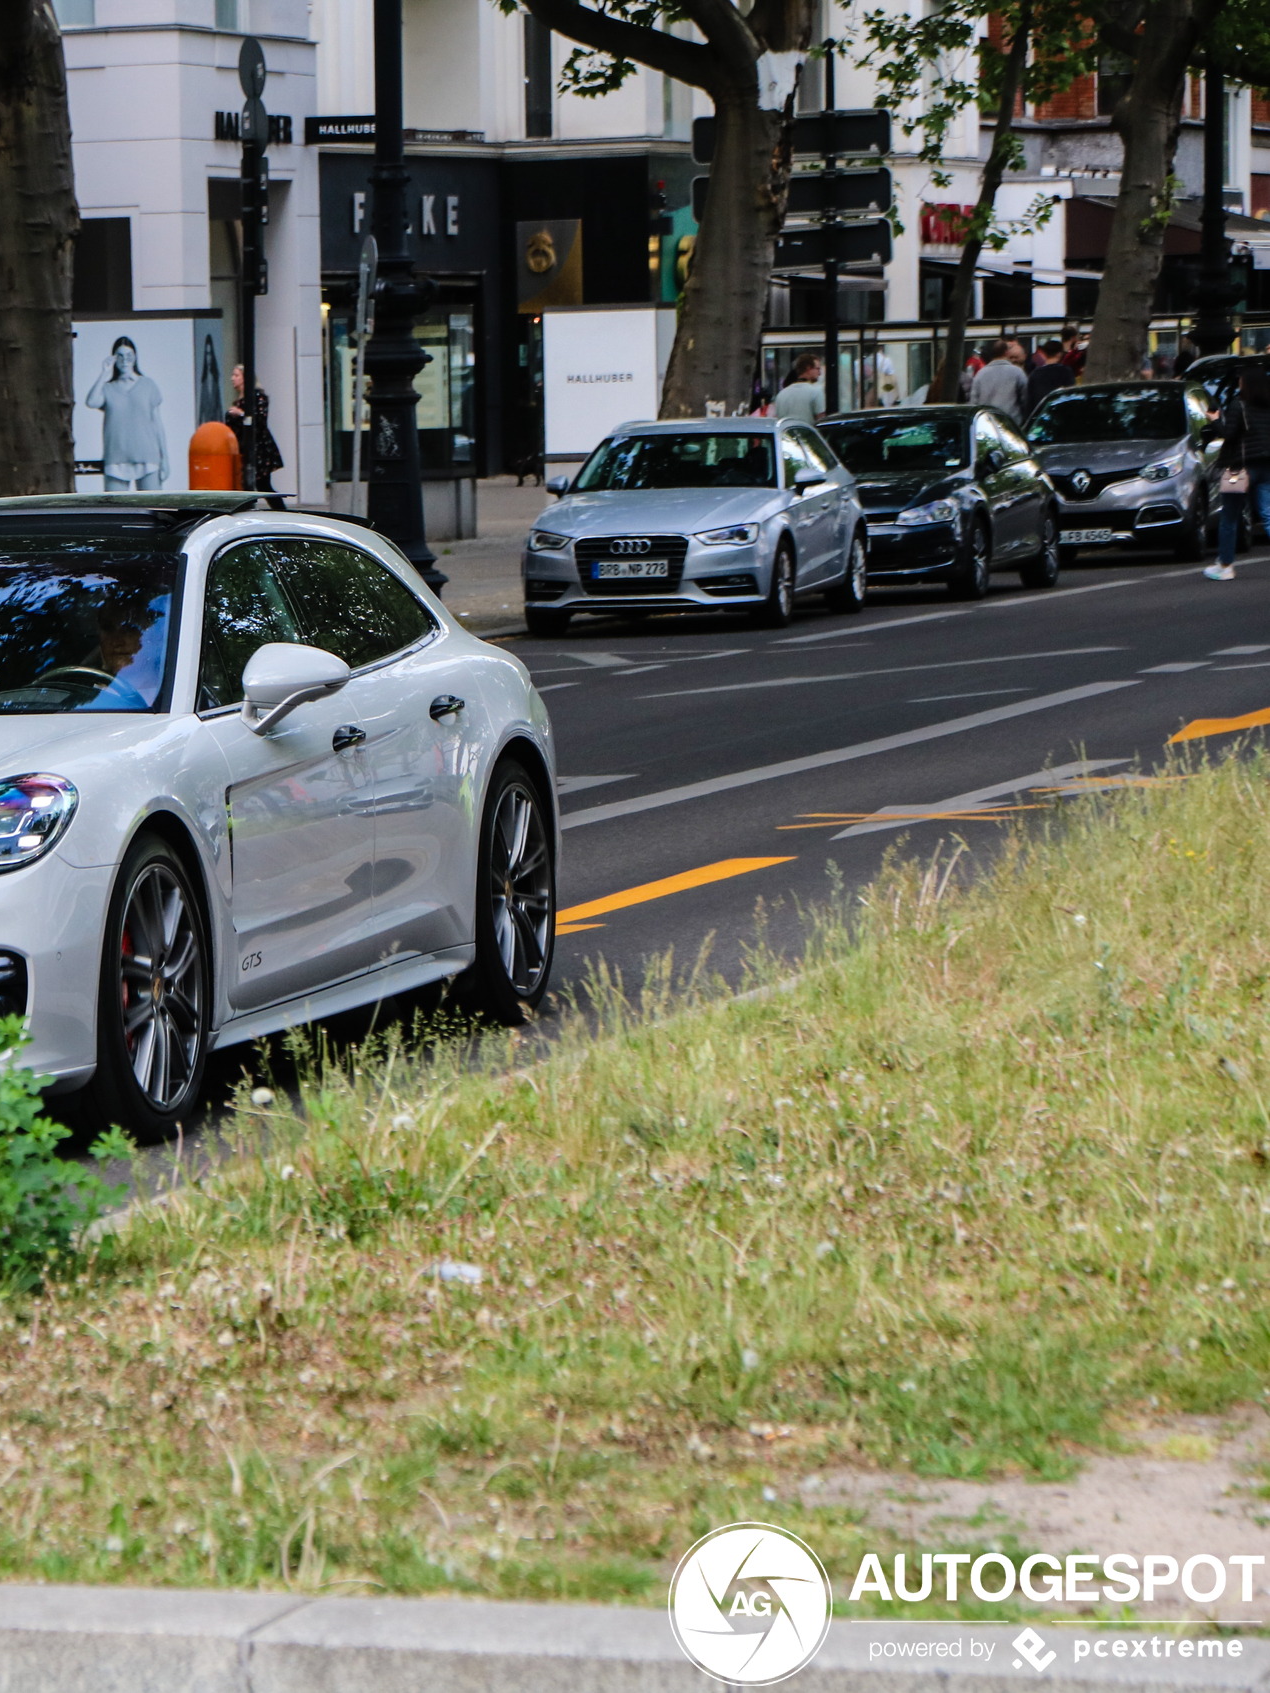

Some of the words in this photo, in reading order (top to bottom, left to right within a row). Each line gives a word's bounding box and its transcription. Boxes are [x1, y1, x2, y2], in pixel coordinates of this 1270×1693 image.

[319, 123, 376, 135] HALLHUBE
[353, 191, 459, 236] FKE
[567, 373, 633, 383] HALLHUBER
[241, 951, 262, 971] GTS
